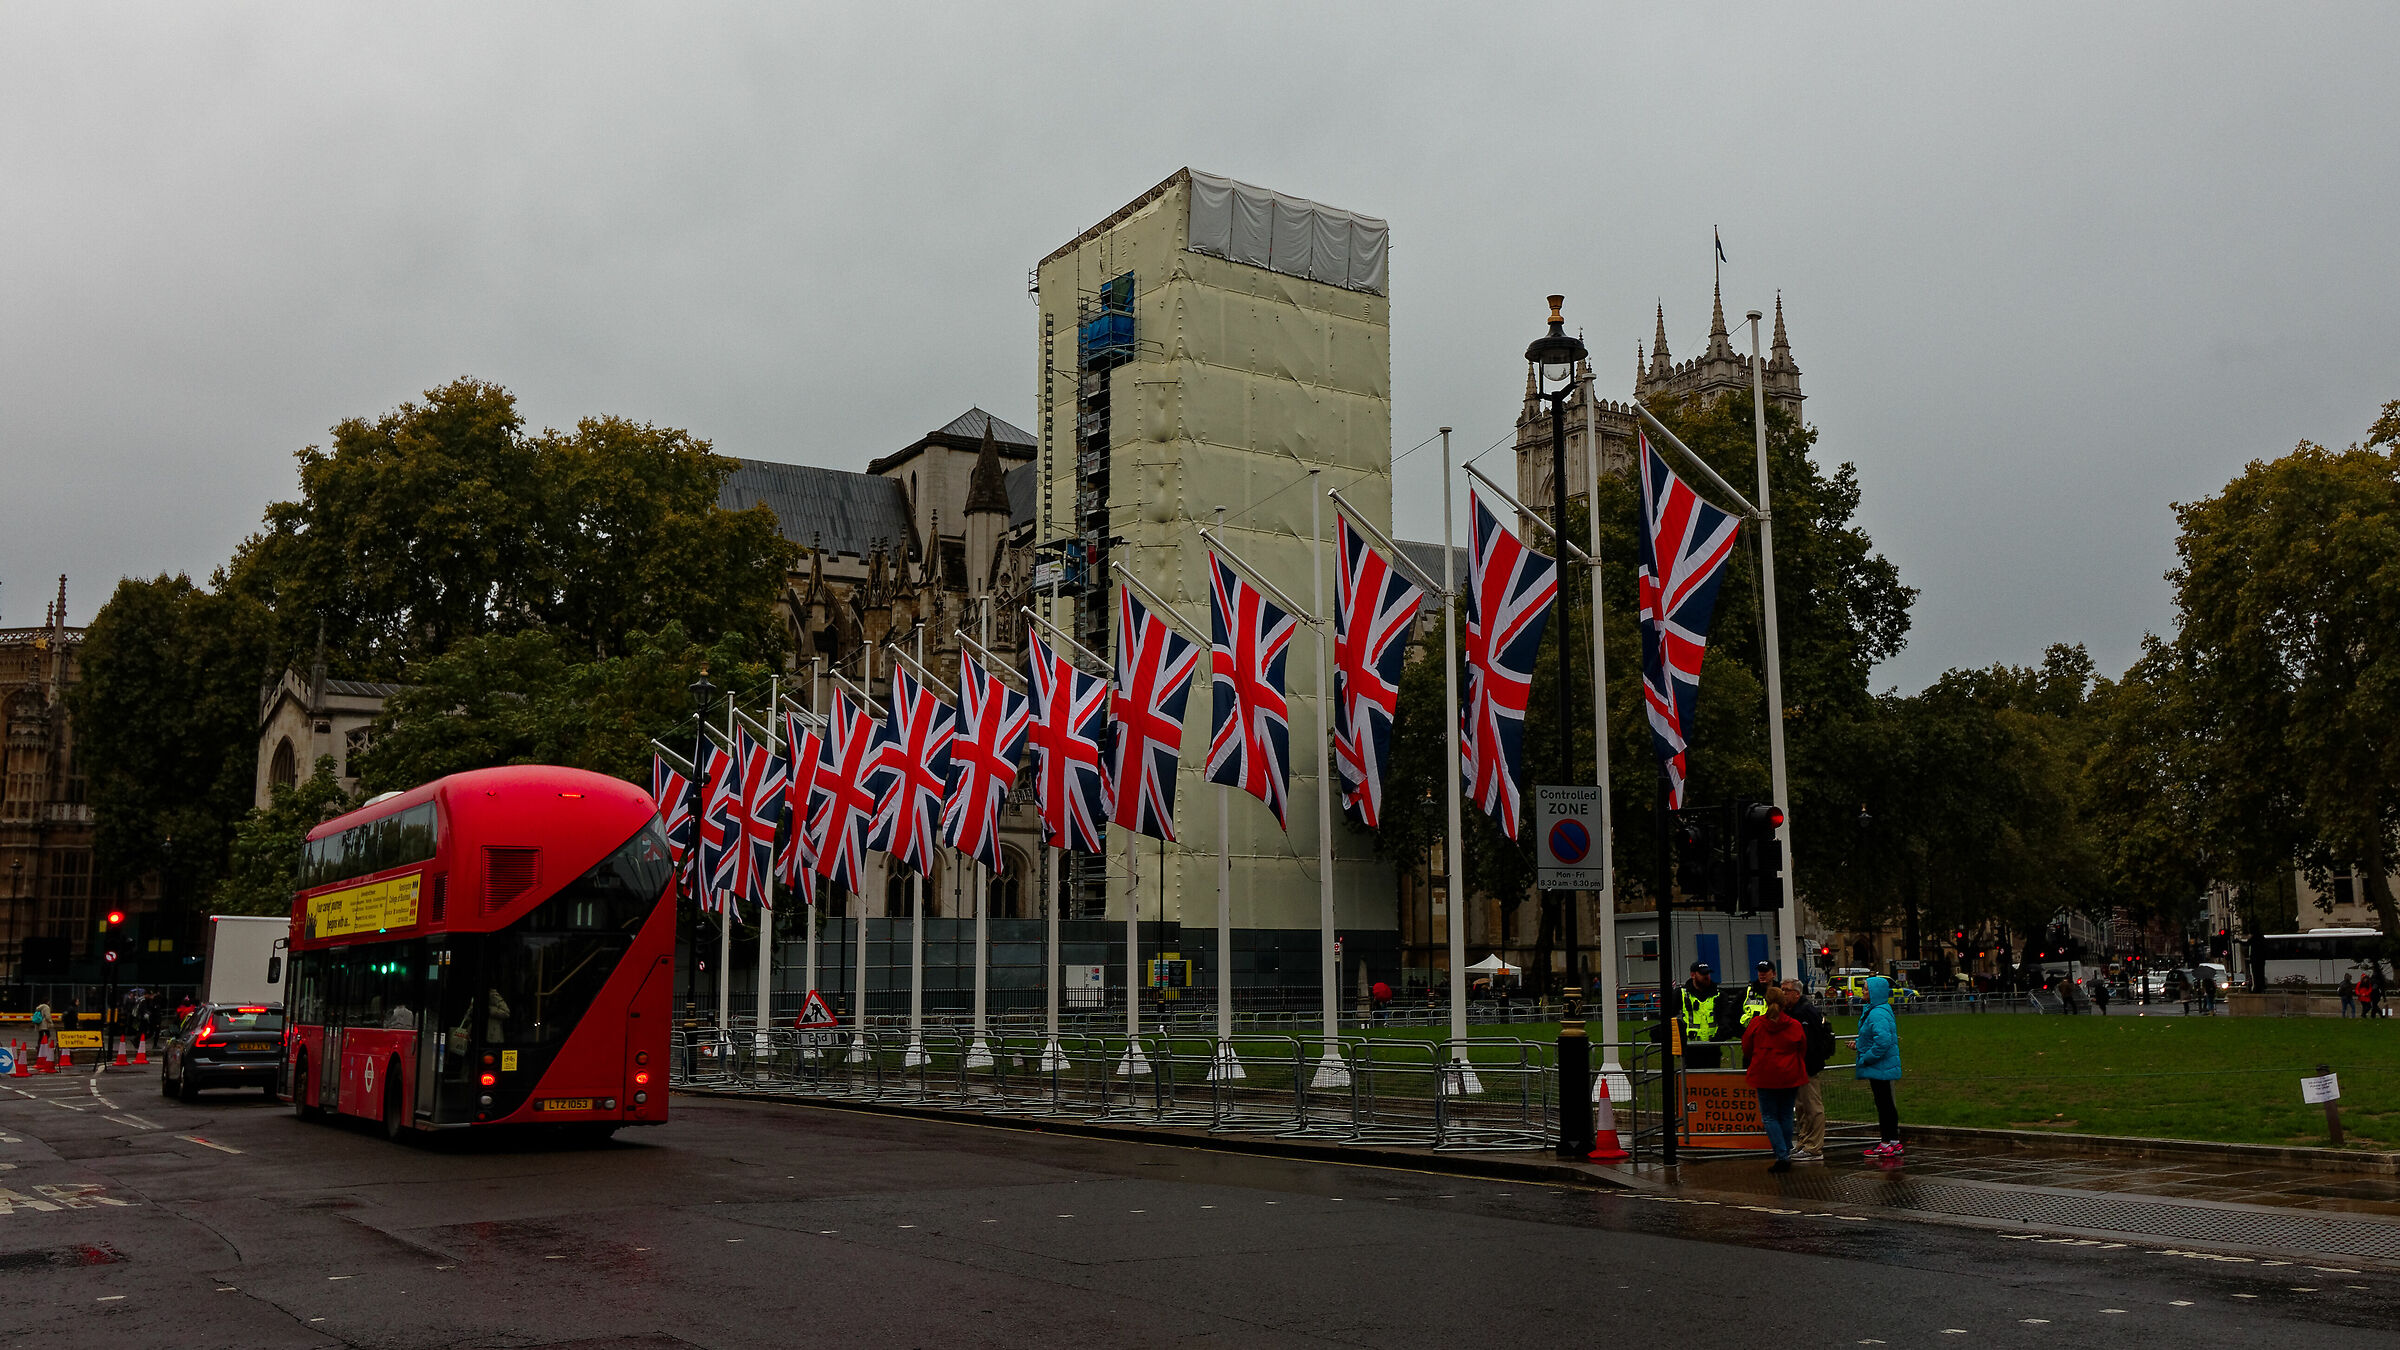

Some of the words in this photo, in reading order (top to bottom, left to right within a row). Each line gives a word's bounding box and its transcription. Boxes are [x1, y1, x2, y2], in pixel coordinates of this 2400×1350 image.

[1540, 789, 1597, 800] Controlled
[1548, 802, 1589, 815] ZONE
[1687, 1087, 1728, 1098] RIDGE
[1705, 1099, 1756, 1110] CLOSED
[1705, 1111, 1756, 1122] FOLLOW
